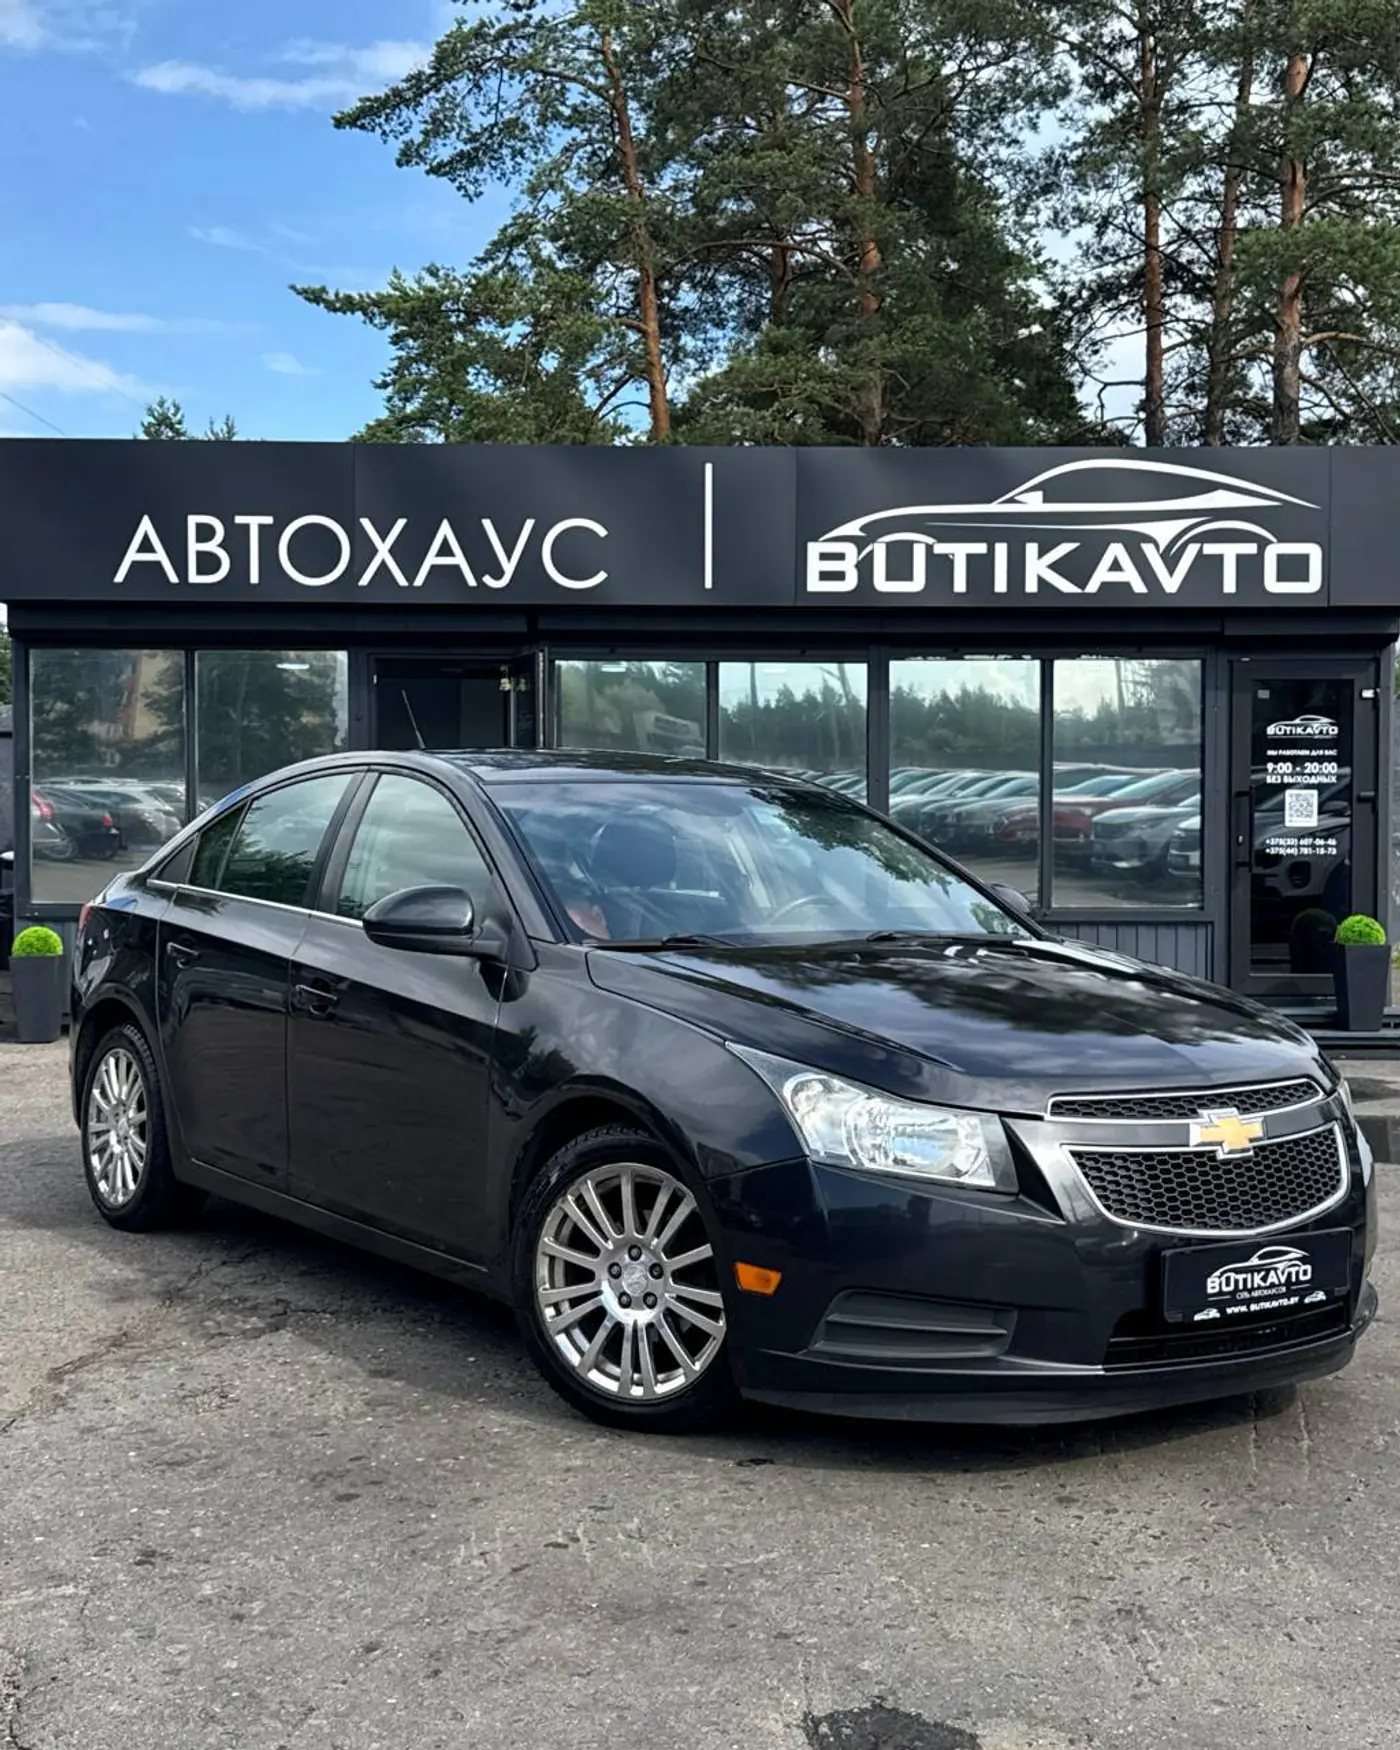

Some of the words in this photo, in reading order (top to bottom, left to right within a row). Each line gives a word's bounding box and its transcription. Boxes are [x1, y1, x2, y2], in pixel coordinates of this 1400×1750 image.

[113, 514, 609, 589] АВТОХАУС
[806, 541, 1323, 594] BUTIKAVTO
[1266, 726, 1339, 735] BUTIKAVTO
[1266, 762, 1293, 774] 9:00
[1304, 762, 1338, 774] 20:00
[1266, 775, 1281, 784] БЕЗ
[1283, 775, 1337, 784] ВЫХОДНЫХ
[1207, 1264, 1312, 1294] BUTIKAVTO
